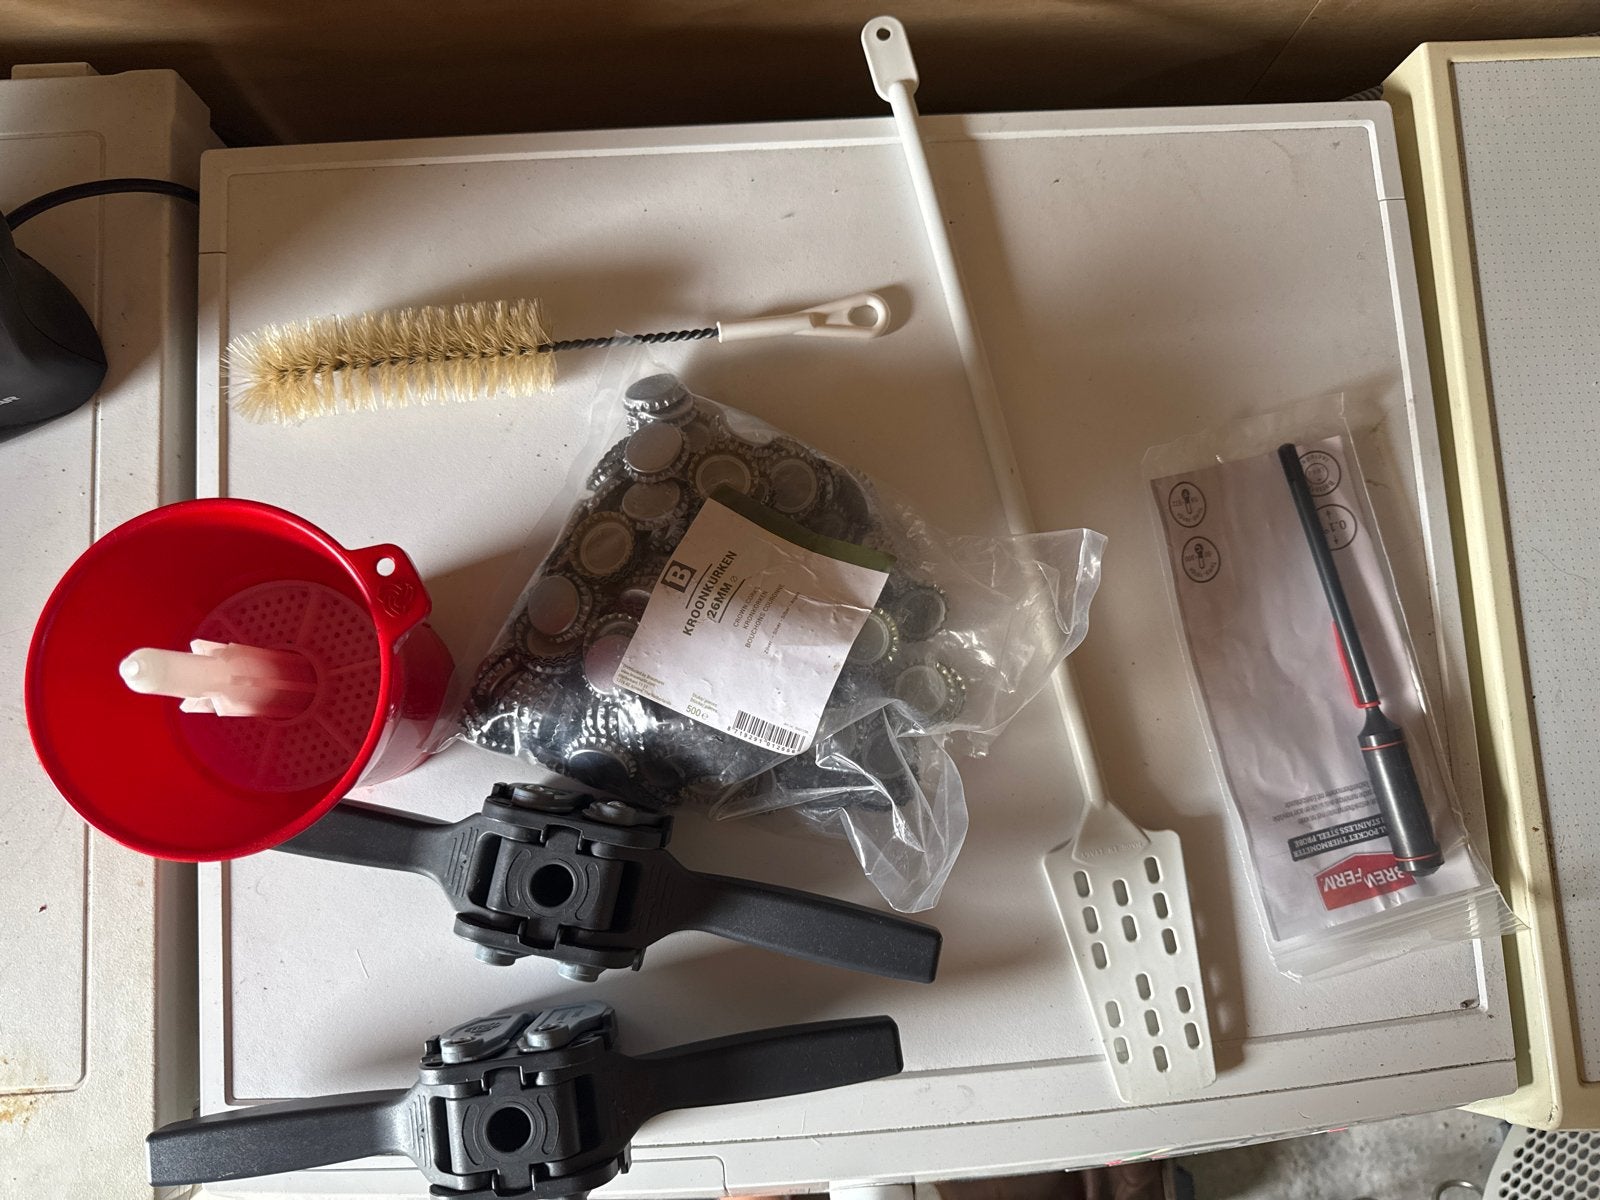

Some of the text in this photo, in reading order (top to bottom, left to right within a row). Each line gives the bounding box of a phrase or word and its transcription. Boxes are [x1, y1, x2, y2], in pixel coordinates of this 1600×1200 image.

[663, 560, 694, 591] B
[681, 549, 737, 636] KROONKURKEN
[705, 581, 733, 619] 26MM
[731, 584, 761, 628] CROWN CORKS
[741, 588, 769, 630] KRONKORKEN
[743, 582, 786, 648] BOUCHONS COURONNE
[685, 704, 702, 717] 500
[1292, 836, 1347, 857] THERMOMETER
[1293, 817, 1379, 847] STAINLESS STEEL PROBE
[1348, 827, 1378, 840] POCKET
